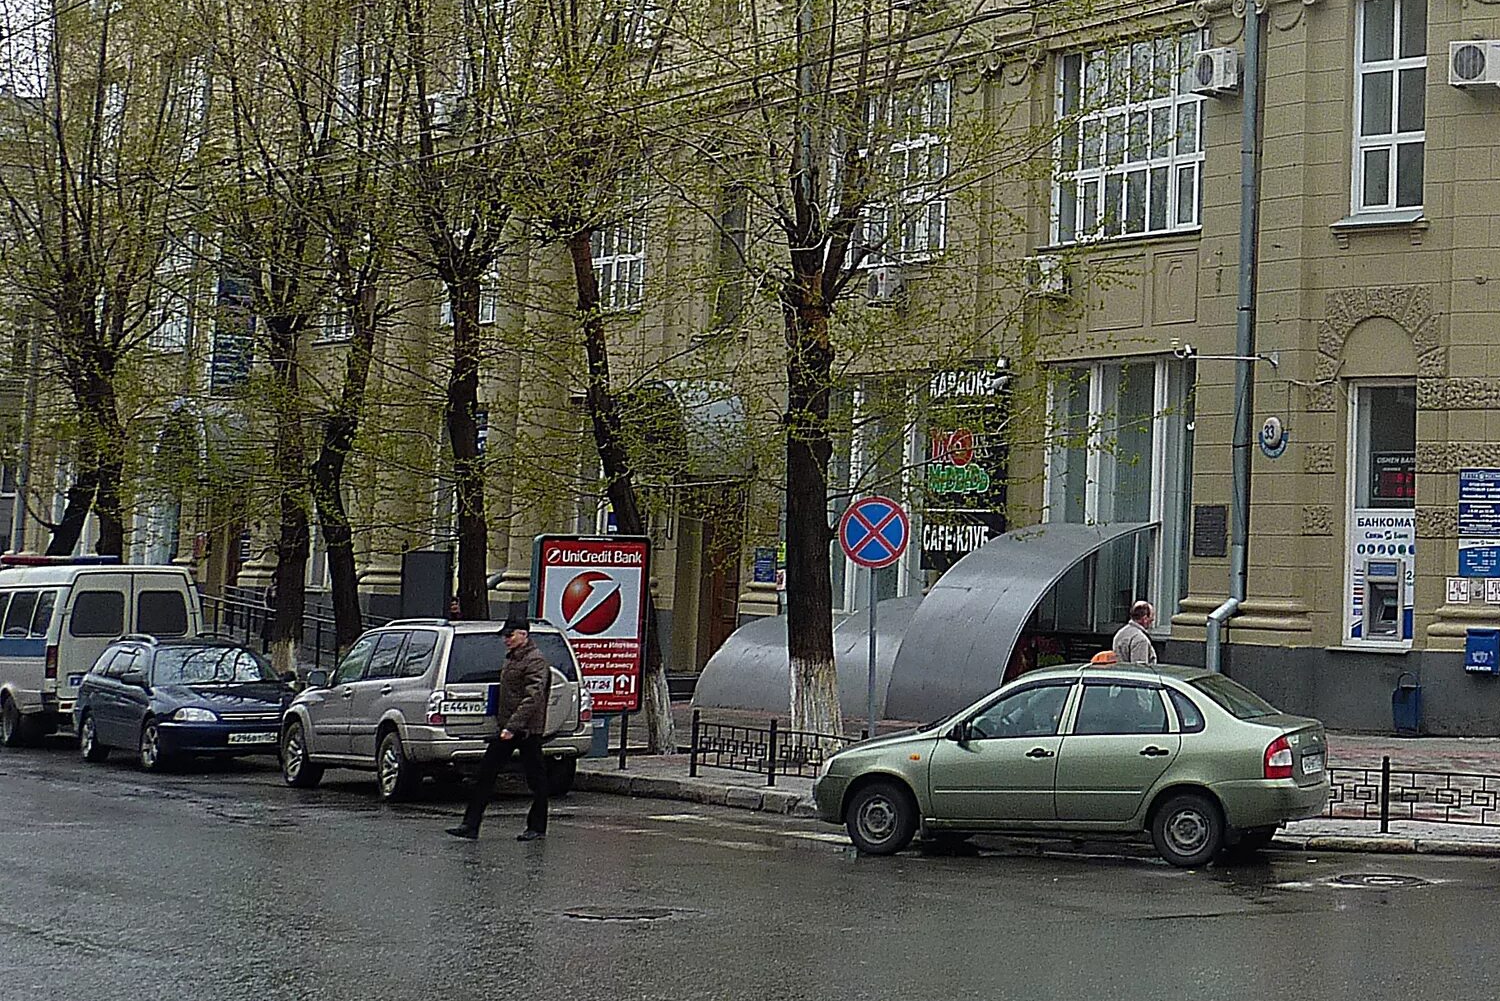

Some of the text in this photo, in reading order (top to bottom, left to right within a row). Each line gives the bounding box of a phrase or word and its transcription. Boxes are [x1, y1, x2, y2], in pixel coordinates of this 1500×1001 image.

[1264, 424, 1275, 440] 33
[1357, 517, 1415, 528] БАНКОМАТ
[562, 549, 642, 564] UniCredit Bank
